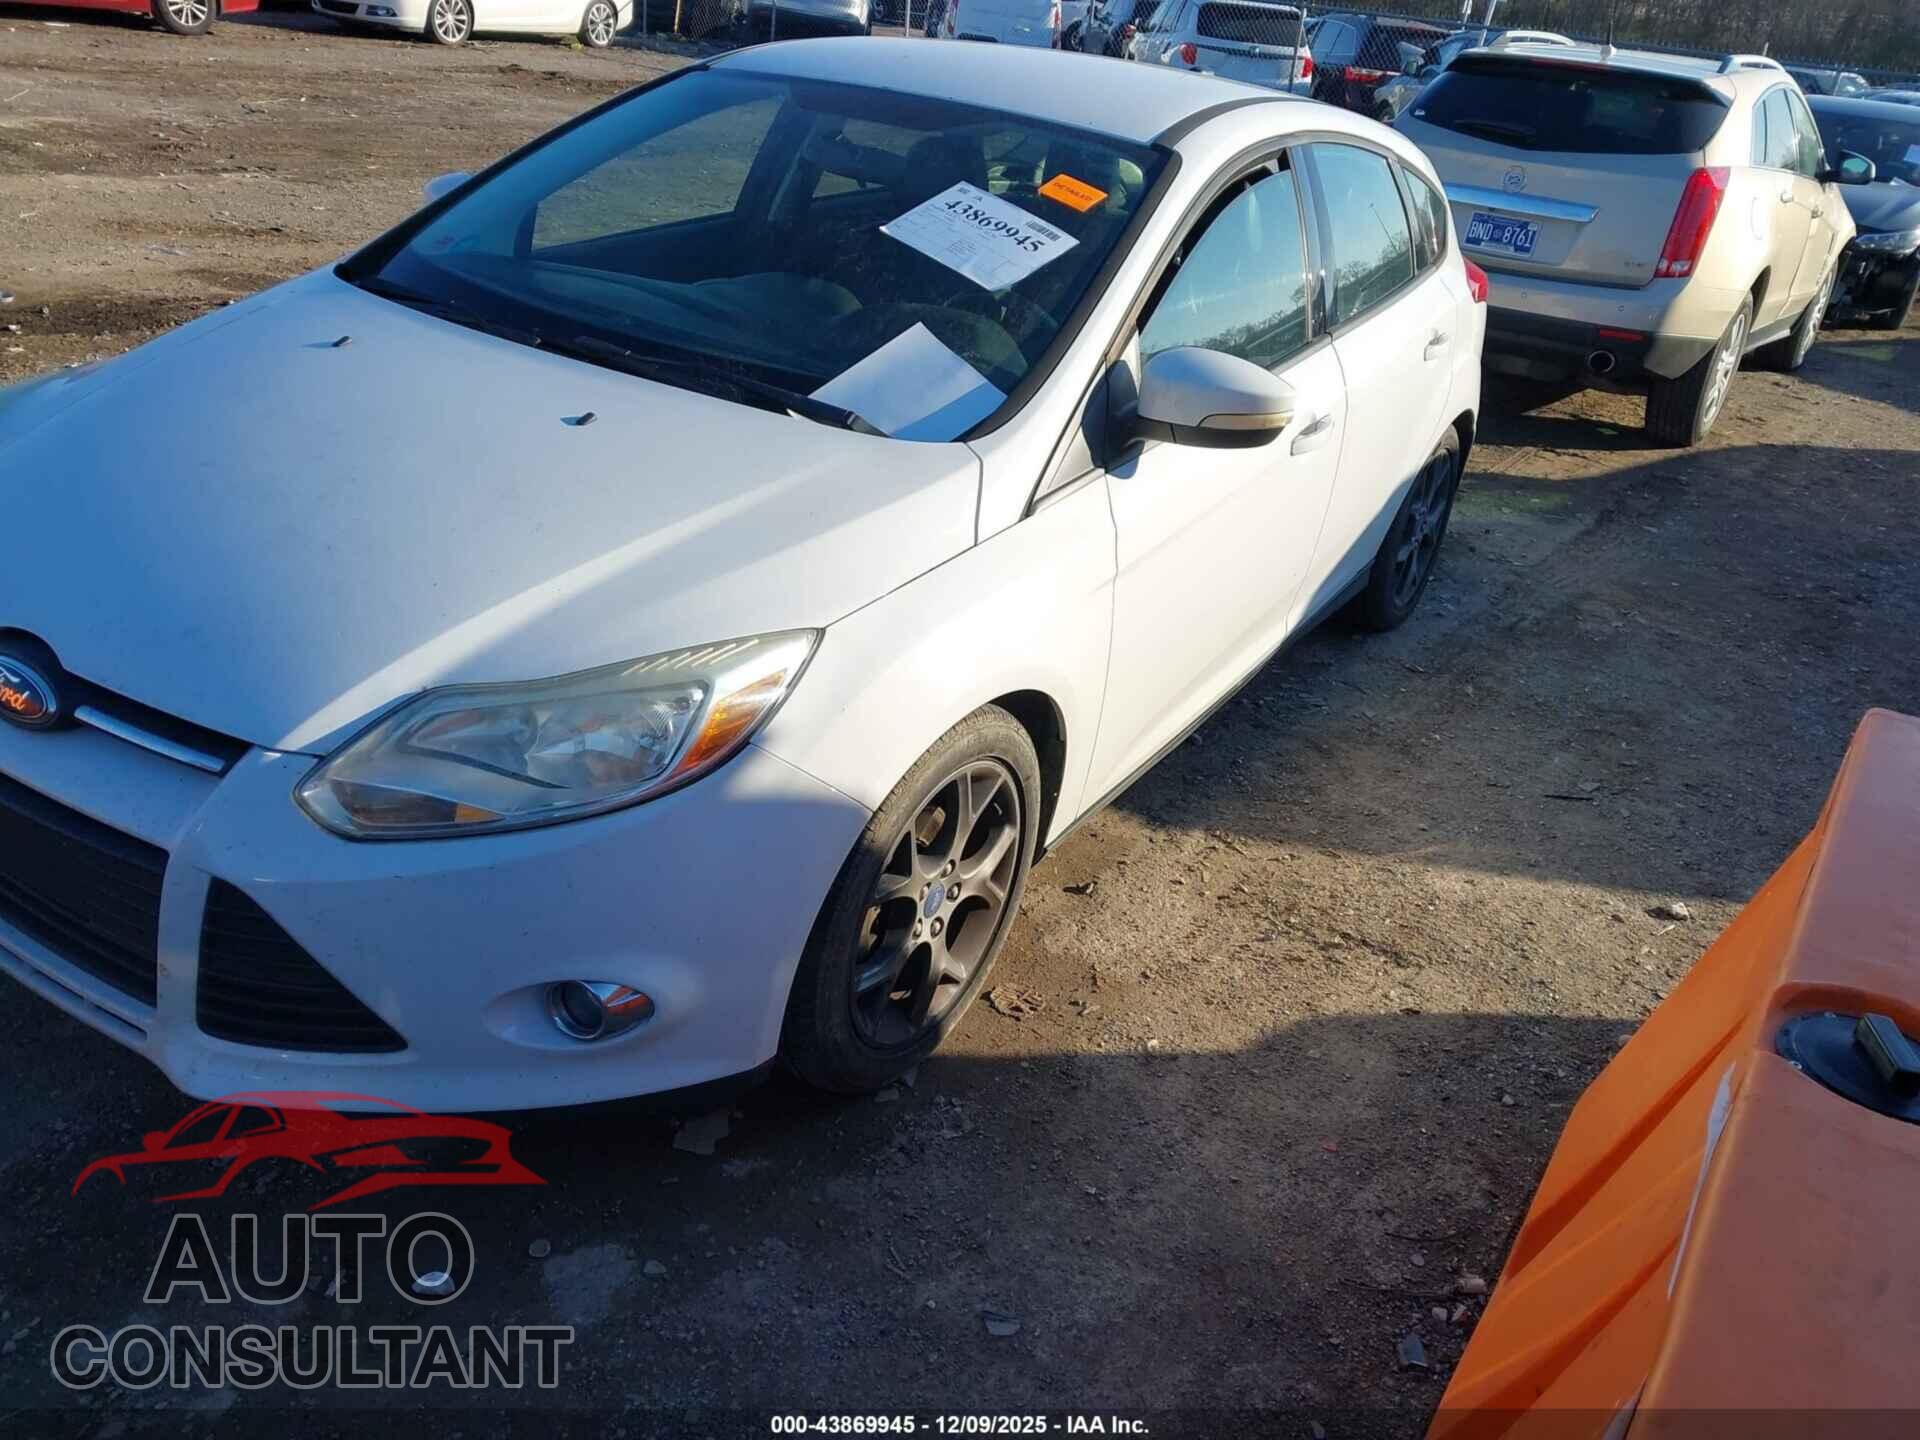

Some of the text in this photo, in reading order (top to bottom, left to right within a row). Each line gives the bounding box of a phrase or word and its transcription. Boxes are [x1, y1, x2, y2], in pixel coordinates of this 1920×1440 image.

[944, 200, 1047, 253] 43869945
[1469, 220, 1494, 241] BND
[1502, 225, 1535, 248] 8761
